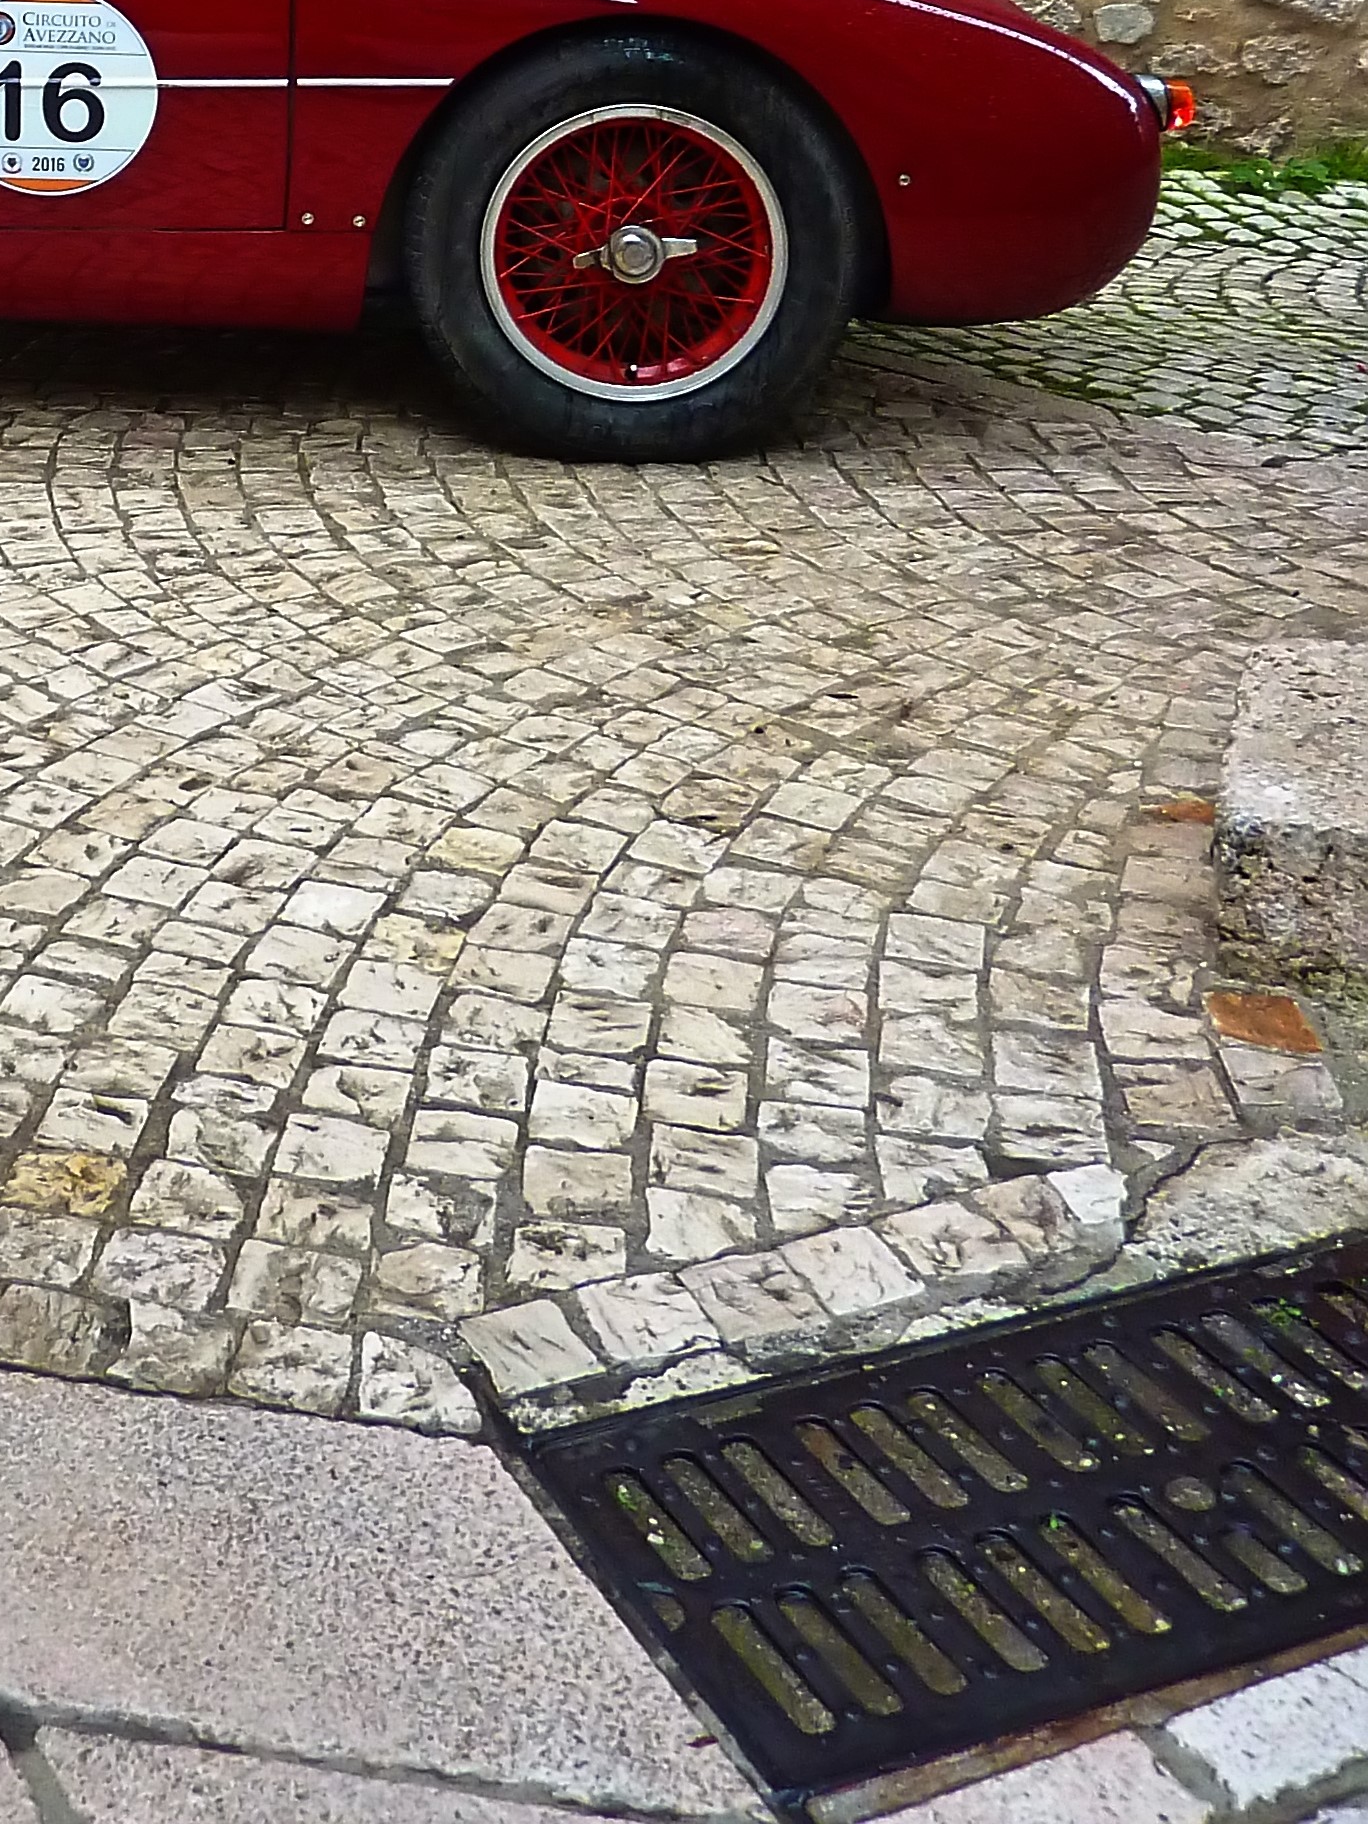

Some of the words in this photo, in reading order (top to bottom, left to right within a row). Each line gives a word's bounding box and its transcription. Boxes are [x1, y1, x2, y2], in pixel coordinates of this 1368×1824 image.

[22, 11, 102, 28] CIRCUITO
[22, 27, 117, 45] AVEZZANO
[32, 156, 66, 172] 2016
